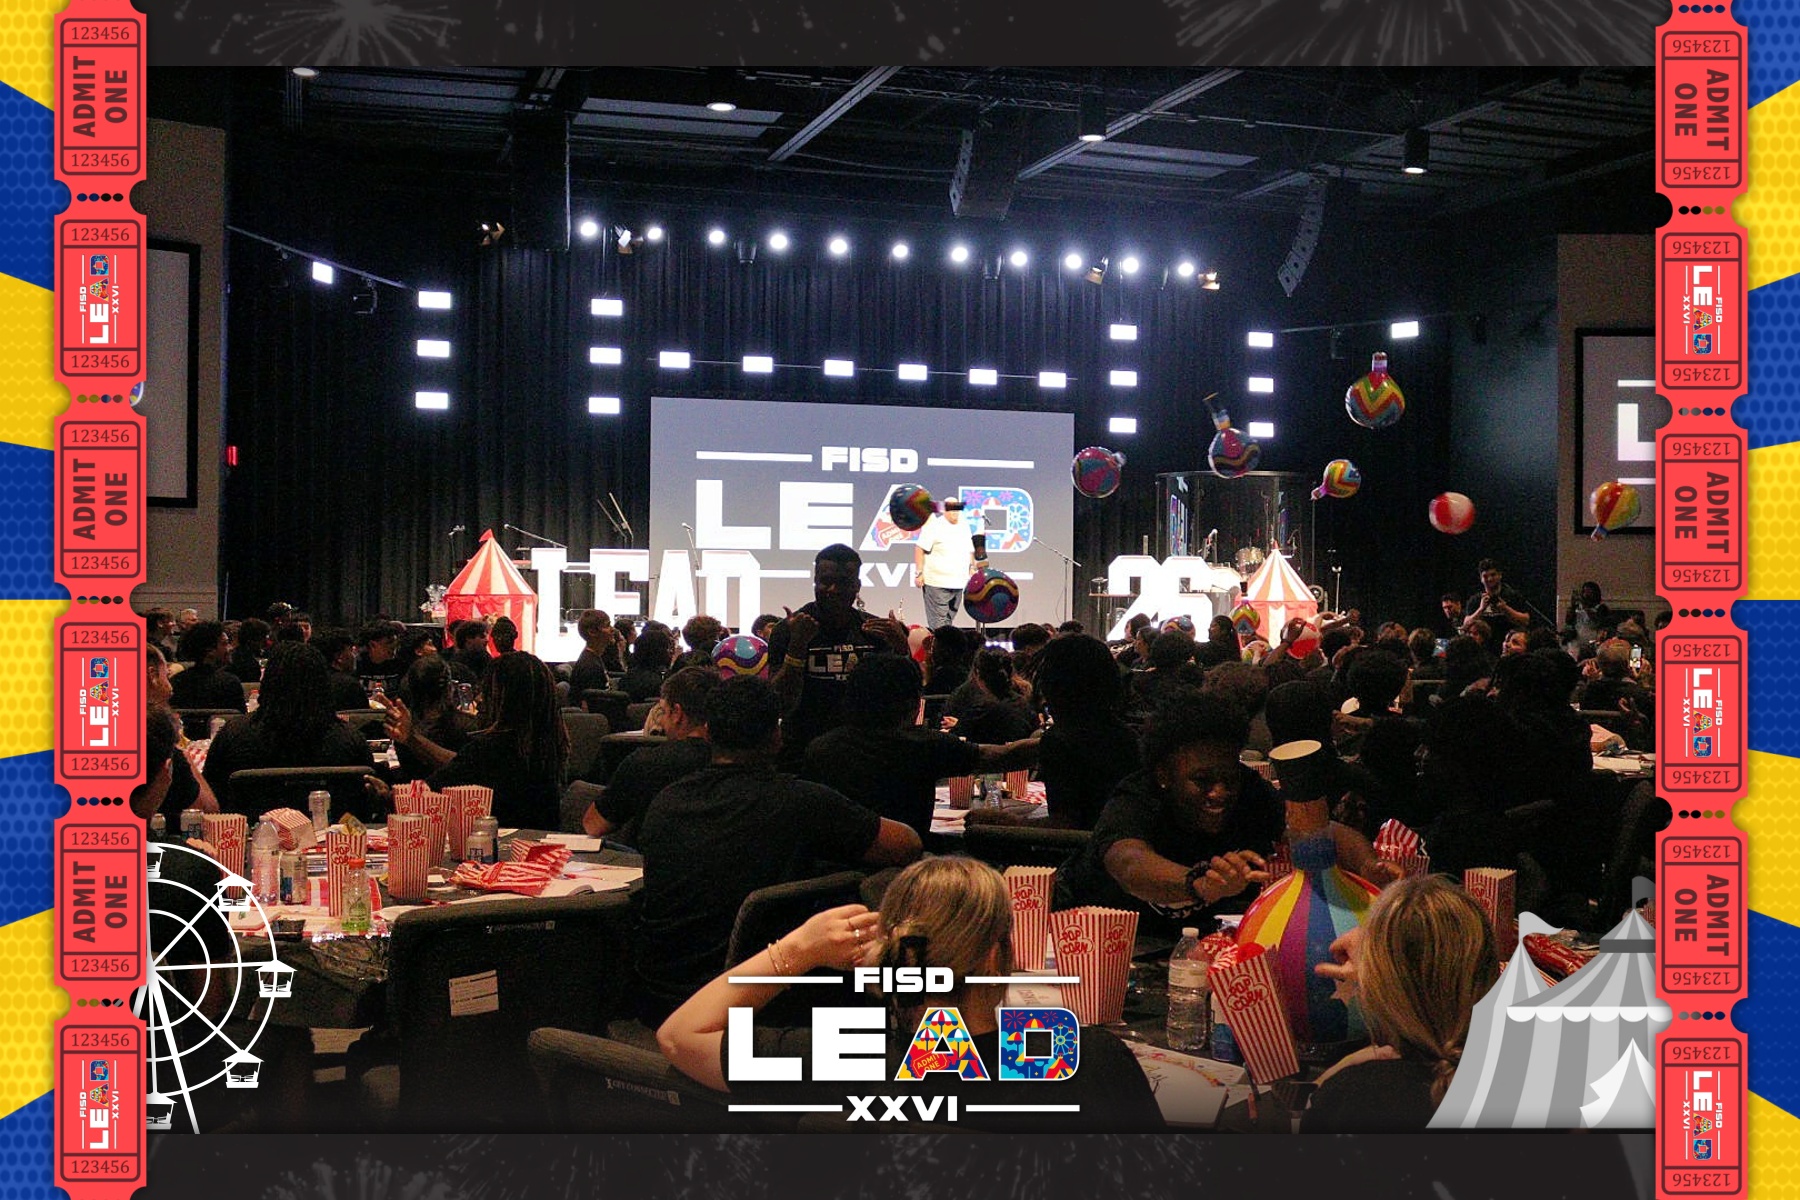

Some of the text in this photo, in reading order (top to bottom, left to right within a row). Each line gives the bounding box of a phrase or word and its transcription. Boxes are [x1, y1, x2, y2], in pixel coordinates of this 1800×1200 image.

[821, 446, 918, 473] FISD
[531, 548, 760, 662] LEAD
[1107, 555, 1213, 642] 26
[808, 652, 862, 672] LEA
[334, 855, 351, 865] COR
[1014, 888, 1032, 901] POP
[1013, 898, 1039, 912] CORN
[1062, 930, 1081, 943] POP
[1108, 929, 1124, 941] POP
[1062, 943, 1088, 955] CORN
[1105, 941, 1127, 955] CORN
[1229, 978, 1252, 995] POP
[1232, 988, 1263, 1011] CORN
